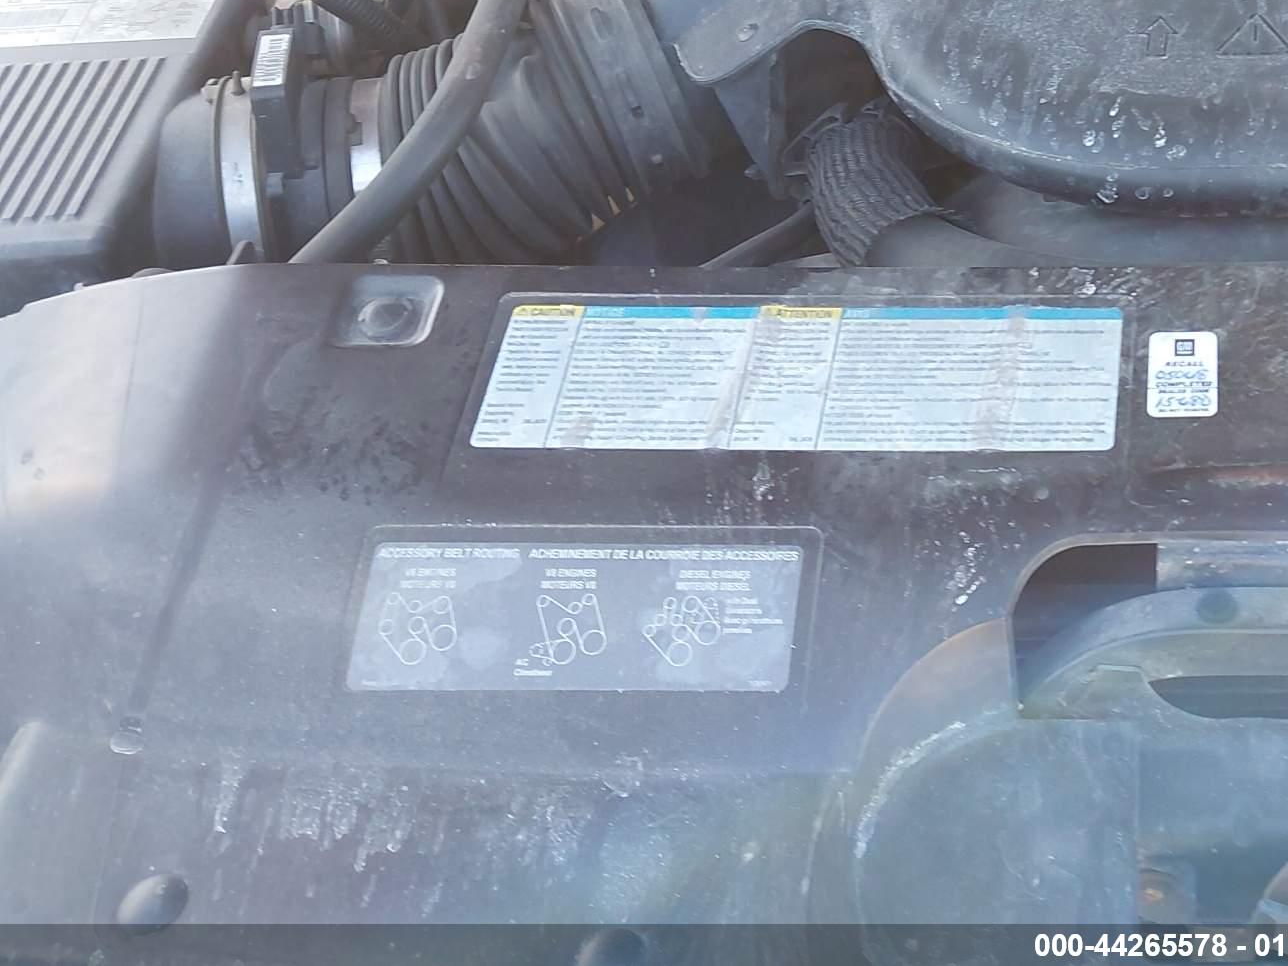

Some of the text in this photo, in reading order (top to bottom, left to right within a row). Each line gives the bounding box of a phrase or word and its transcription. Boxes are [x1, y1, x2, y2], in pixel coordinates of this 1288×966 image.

[378, 547, 520, 559] ACCESSORY BELT ROUTING
[528, 548, 800, 562] ACHEMINEMENT DE LA COURROIE DES ACCESSOIRES
[557, 568, 598, 578] ENGINES
[679, 569, 711, 579] DIESEL
